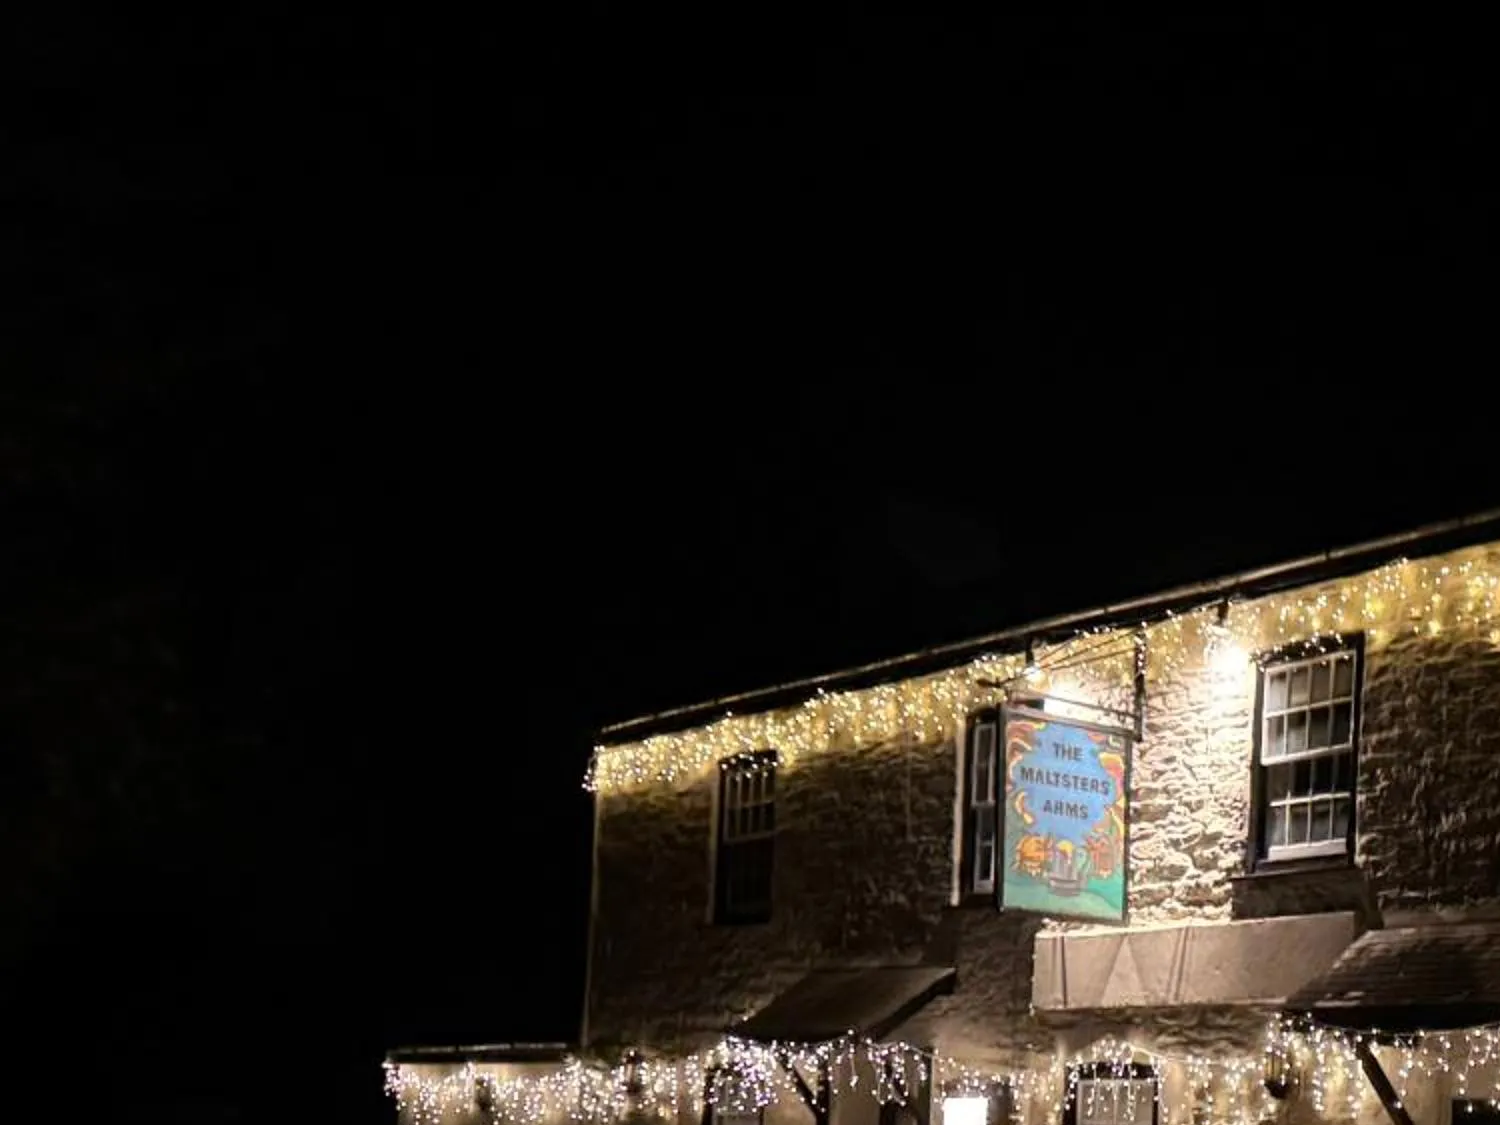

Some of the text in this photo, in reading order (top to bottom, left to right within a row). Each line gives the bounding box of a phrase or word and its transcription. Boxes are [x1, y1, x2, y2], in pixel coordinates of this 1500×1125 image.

[1053, 742, 1083, 761] THE
[1020, 766, 1110, 796] MALTSTERS
[1043, 799, 1089, 820] ARMS
